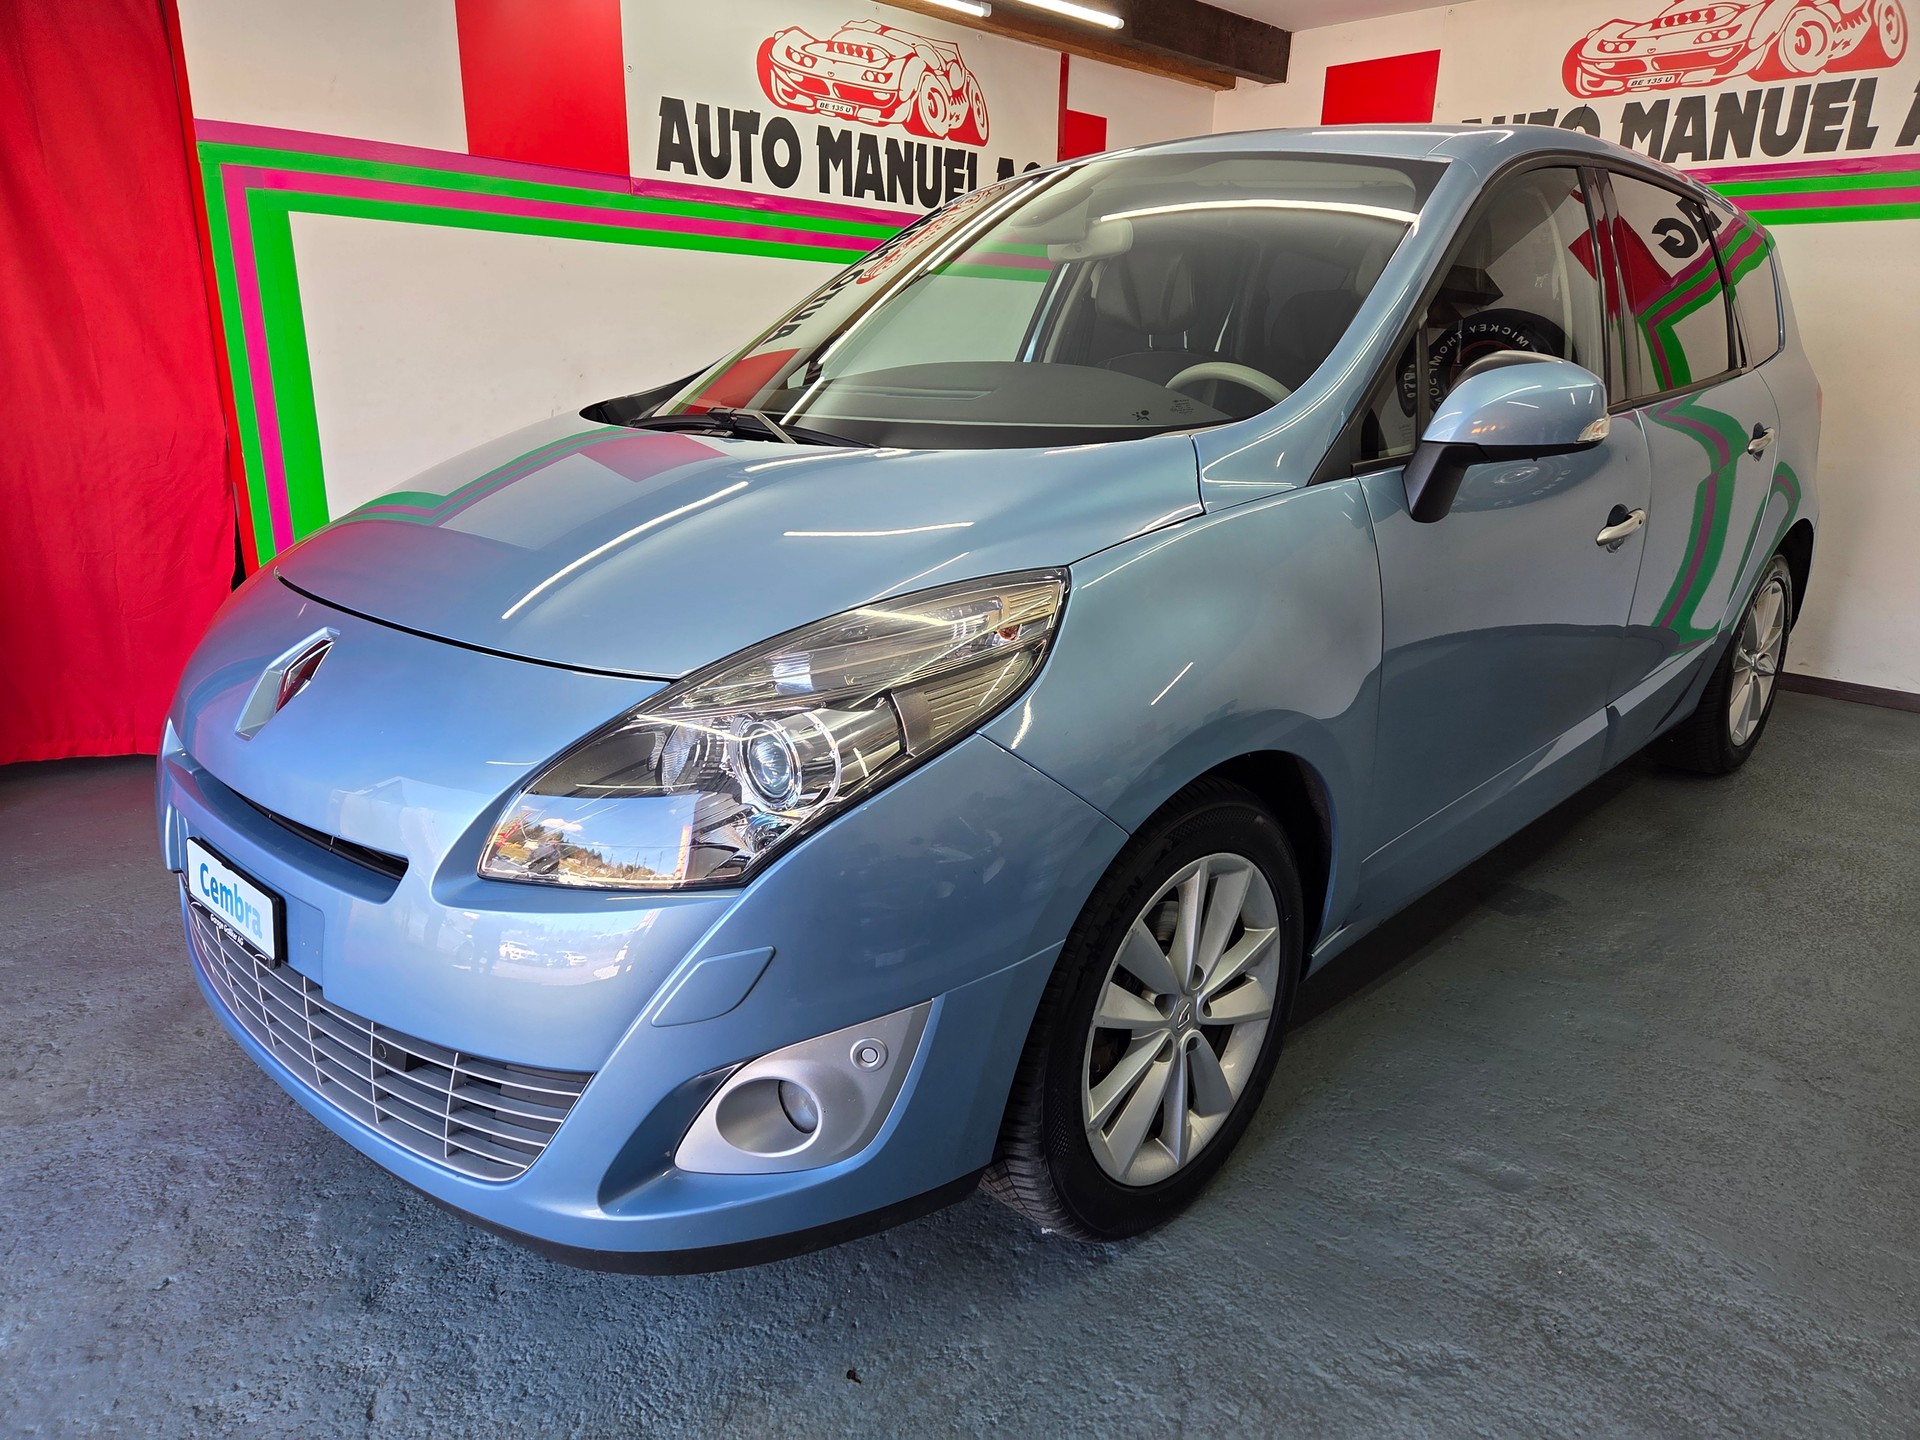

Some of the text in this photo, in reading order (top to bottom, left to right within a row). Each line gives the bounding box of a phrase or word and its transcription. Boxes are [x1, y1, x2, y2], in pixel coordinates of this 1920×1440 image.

[819, 102, 830, 110] BE
[831, 104, 844, 112] 135
[1620, 77, 1879, 163] MANUEL
[656, 96, 977, 208] AUTO MANUEL
[200, 862, 262, 939] Cembra
